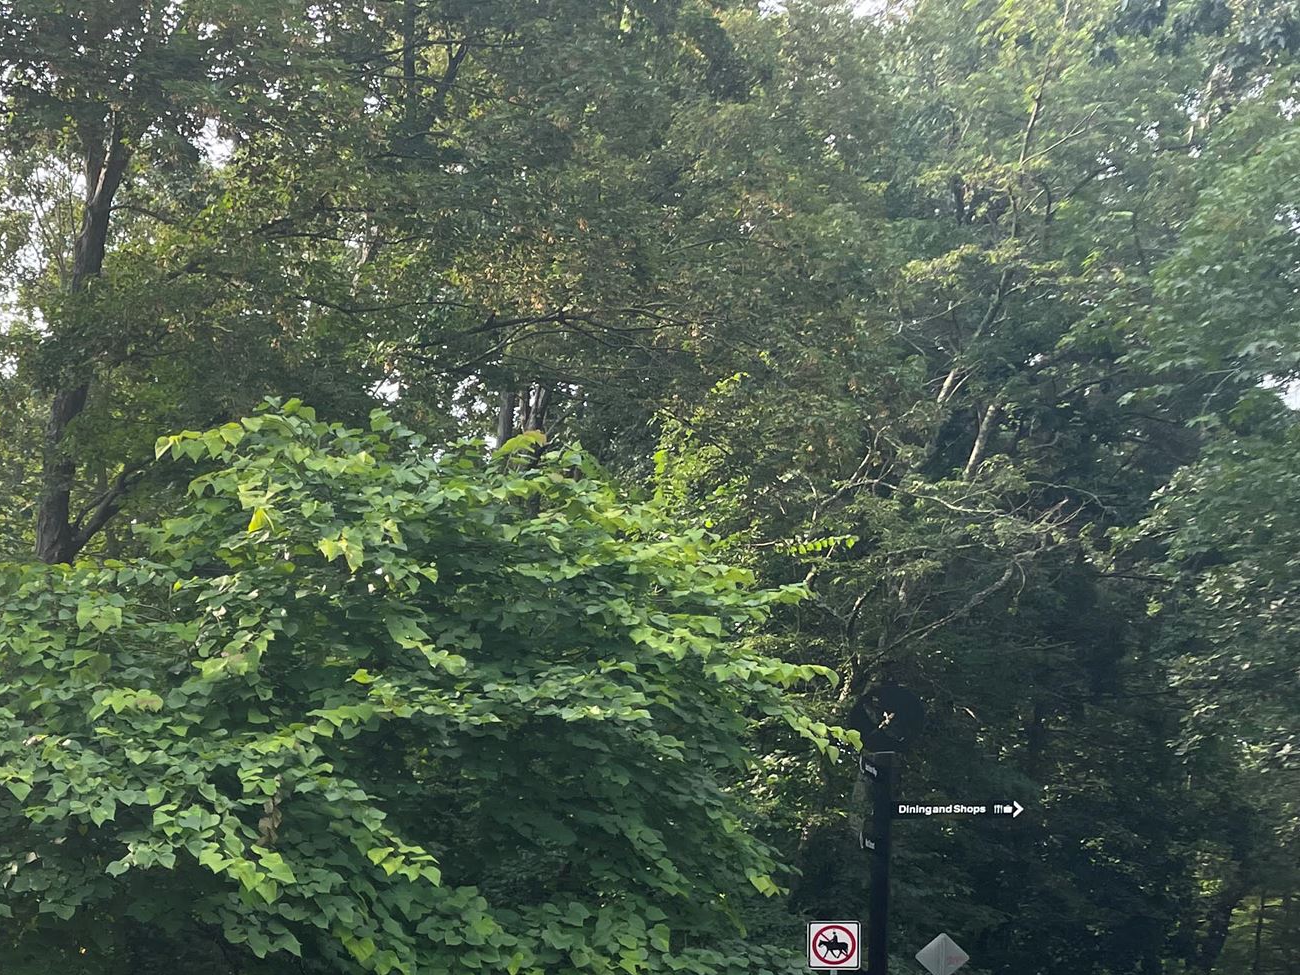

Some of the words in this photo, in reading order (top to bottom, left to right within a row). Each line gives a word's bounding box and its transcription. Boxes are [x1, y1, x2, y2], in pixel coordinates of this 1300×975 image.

[898, 804, 932, 815] Dining
[932, 804, 952, 814] and
[953, 804, 986, 815] Shops
